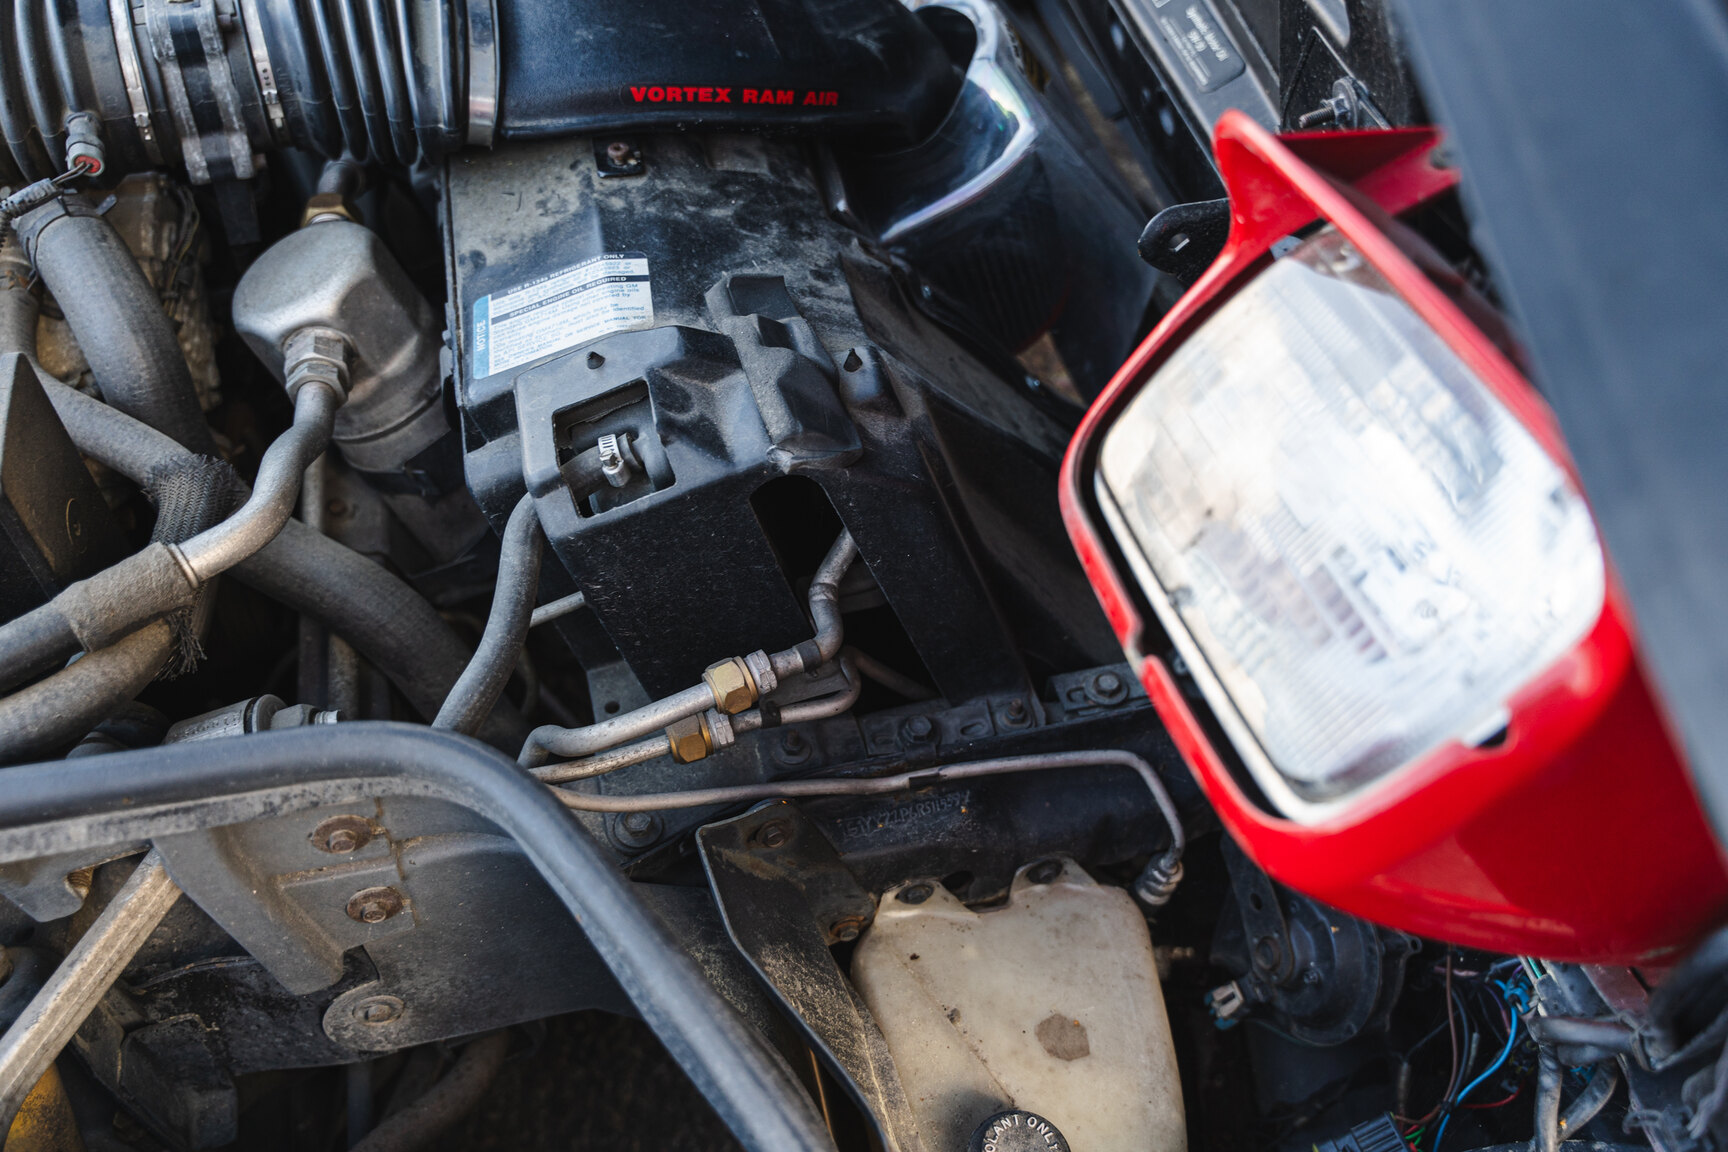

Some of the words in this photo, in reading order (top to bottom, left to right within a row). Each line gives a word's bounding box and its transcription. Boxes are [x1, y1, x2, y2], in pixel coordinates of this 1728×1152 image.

[630, 86, 731, 103] VORTEX
[742, 89, 794, 105] RAM
[803, 91, 839, 106] AIR
[508, 286, 522, 295] USE
[550, 256, 602, 278] REFRIGERANT
[510, 304, 541, 317] SPECIAL
[543, 292, 571, 306] ENGINE
[571, 286, 583, 297] OIL
[586, 276, 627, 289] REQUIRED
[477, 320, 486, 351] NOTICE
[1026, 1116, 1059, 1152] ONLY
